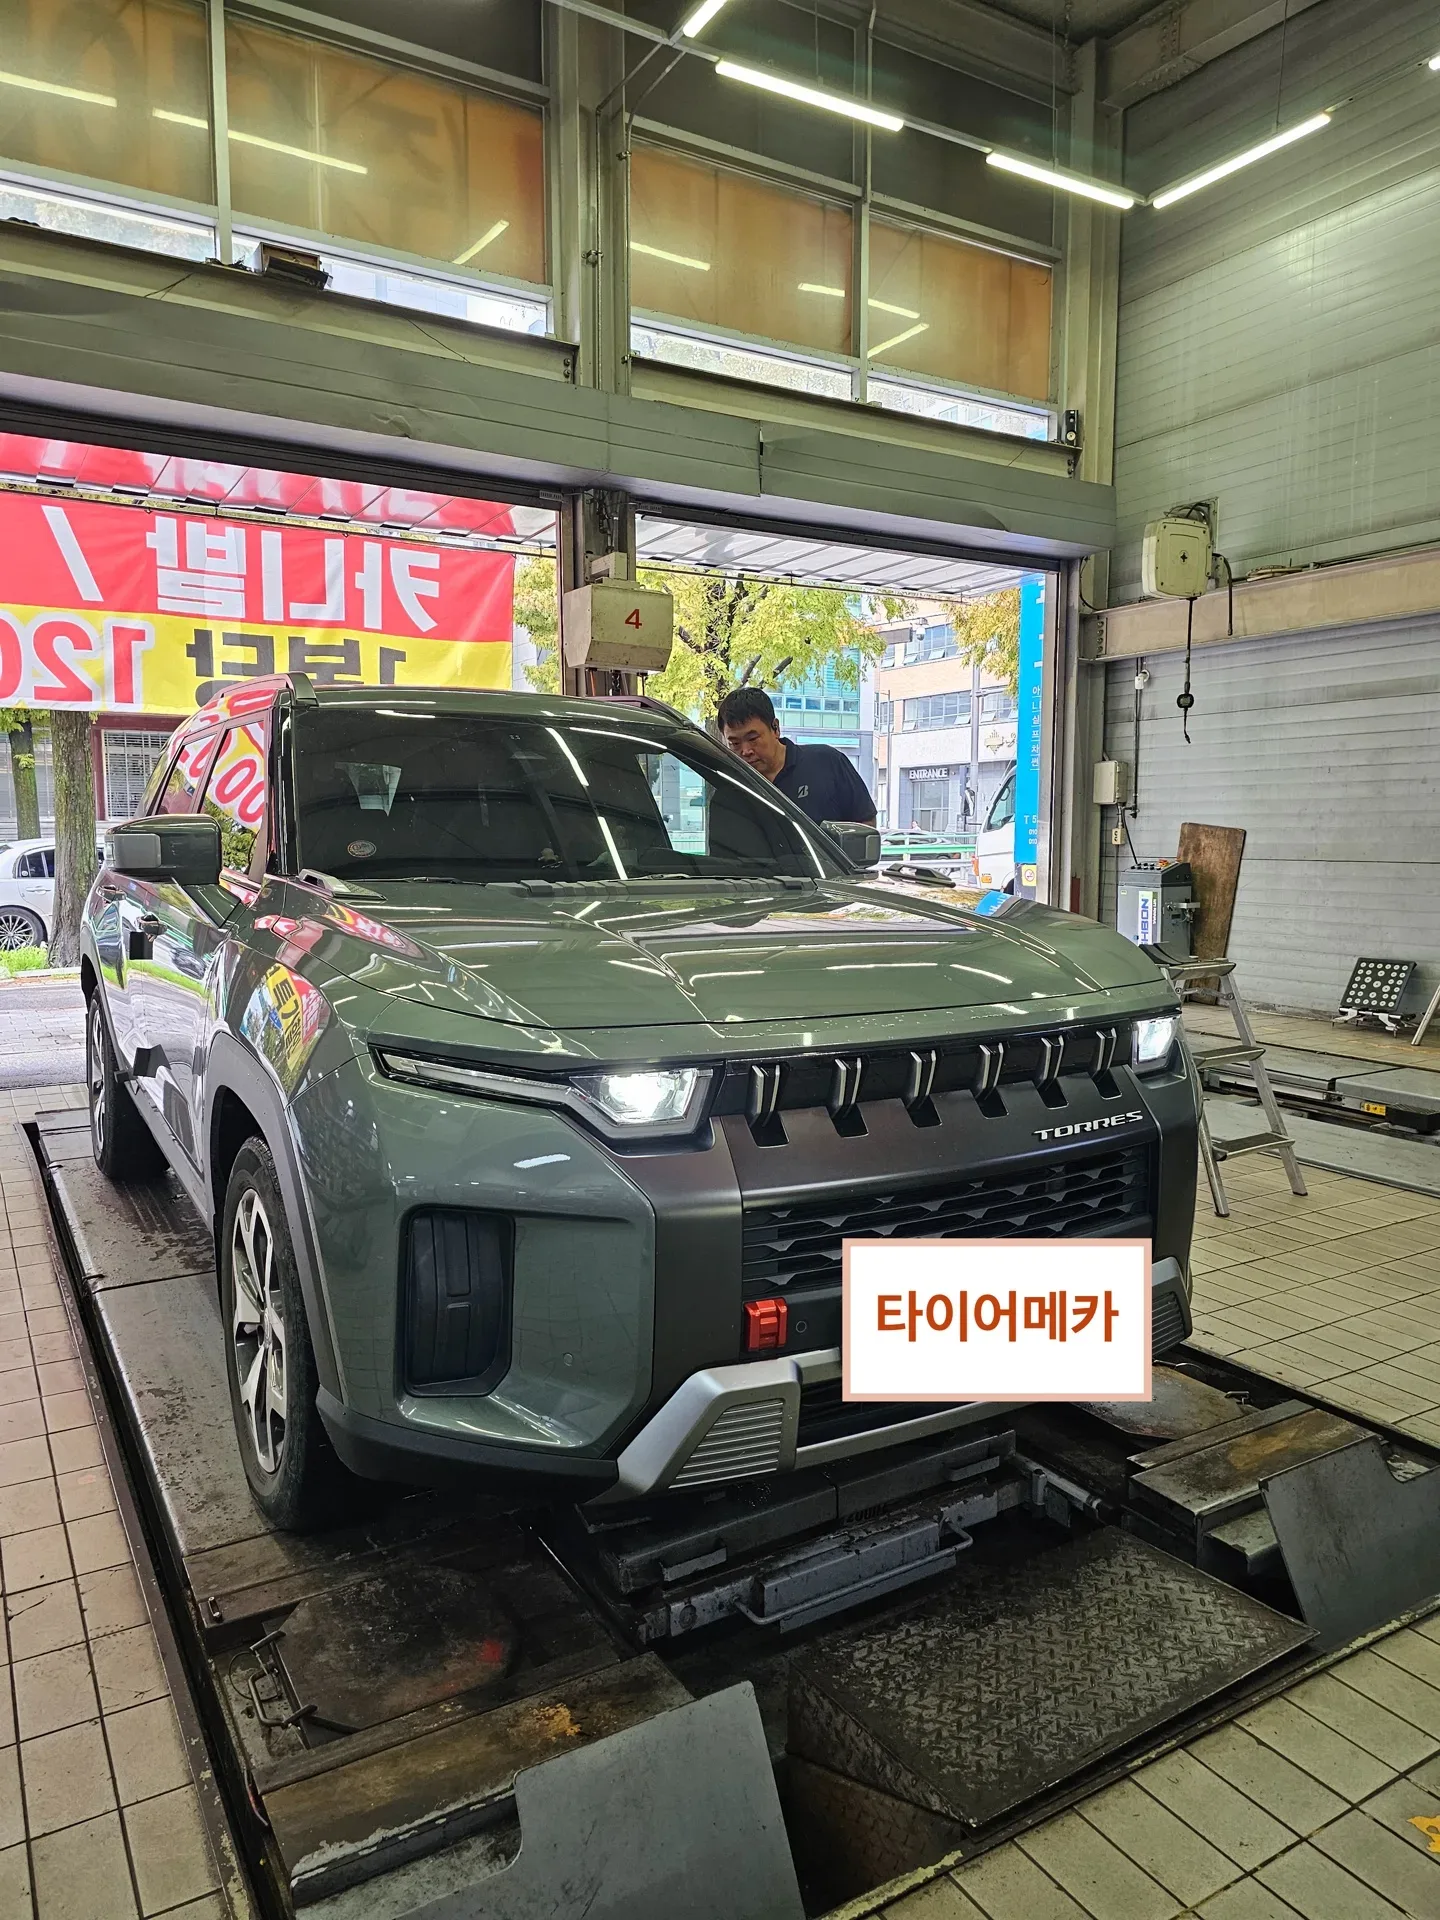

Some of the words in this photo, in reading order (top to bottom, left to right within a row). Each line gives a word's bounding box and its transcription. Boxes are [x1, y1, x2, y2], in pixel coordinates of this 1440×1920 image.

[624, 608, 643, 630] 4
[909, 767, 948, 780] ENTRANCE
[1140, 898, 1149, 944] HBON
[1033, 1110, 1144, 1141] TORRES
